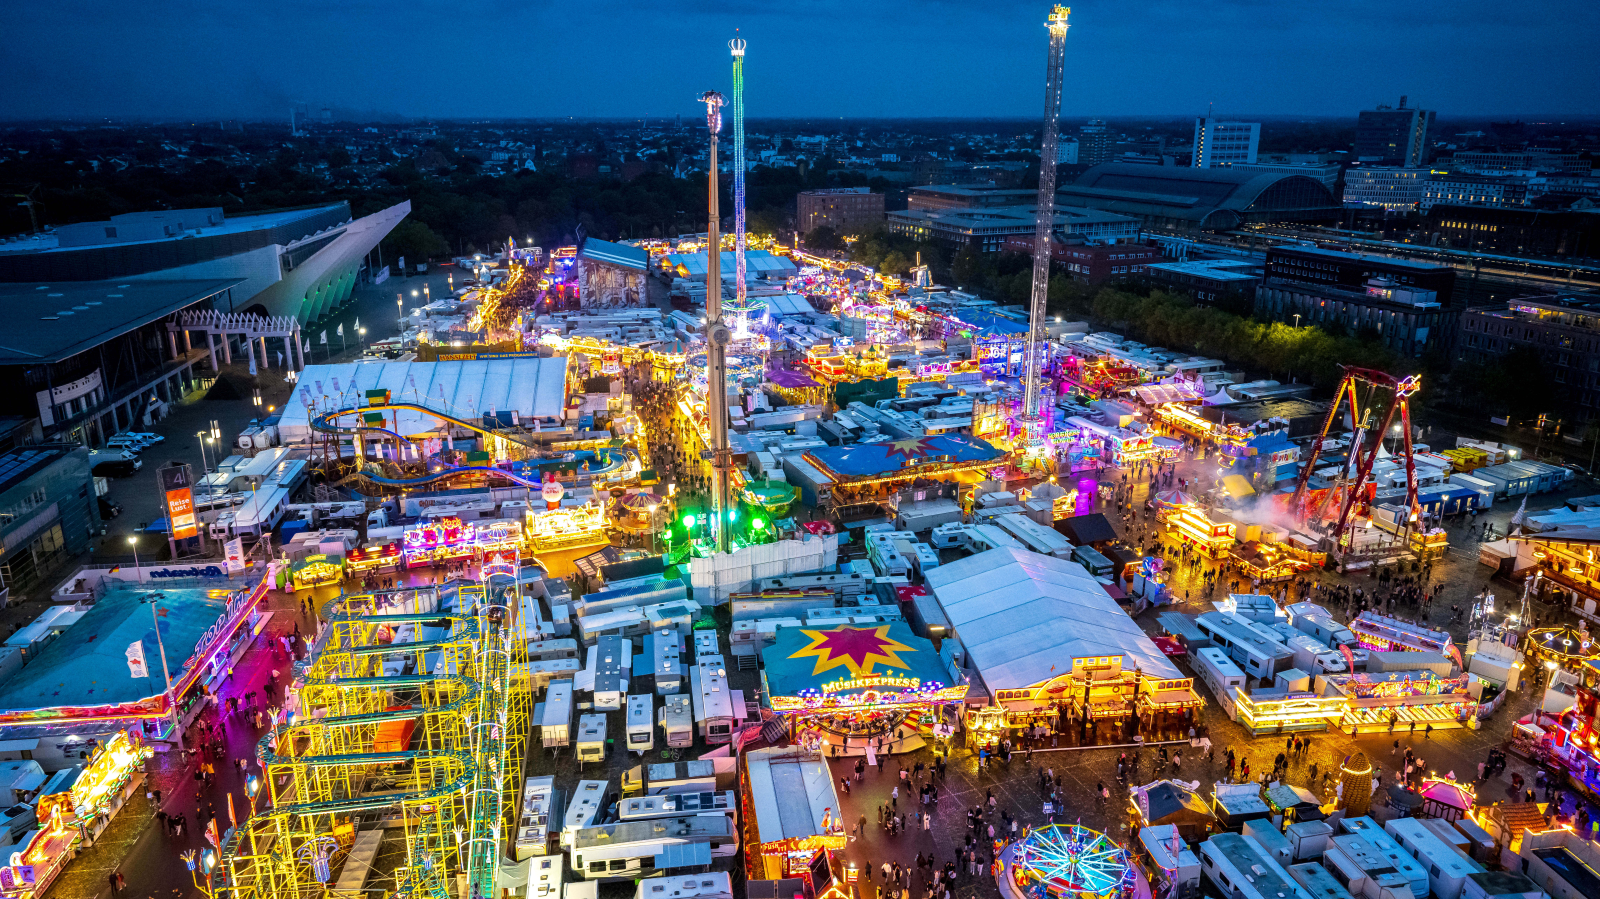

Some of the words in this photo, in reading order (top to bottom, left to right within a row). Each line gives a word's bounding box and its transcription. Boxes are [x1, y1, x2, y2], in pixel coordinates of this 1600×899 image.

[169, 498, 190, 507] Reise
[194, 613, 226, 657] TOP
[821, 676, 921, 694] MUSIKEXPRESS
